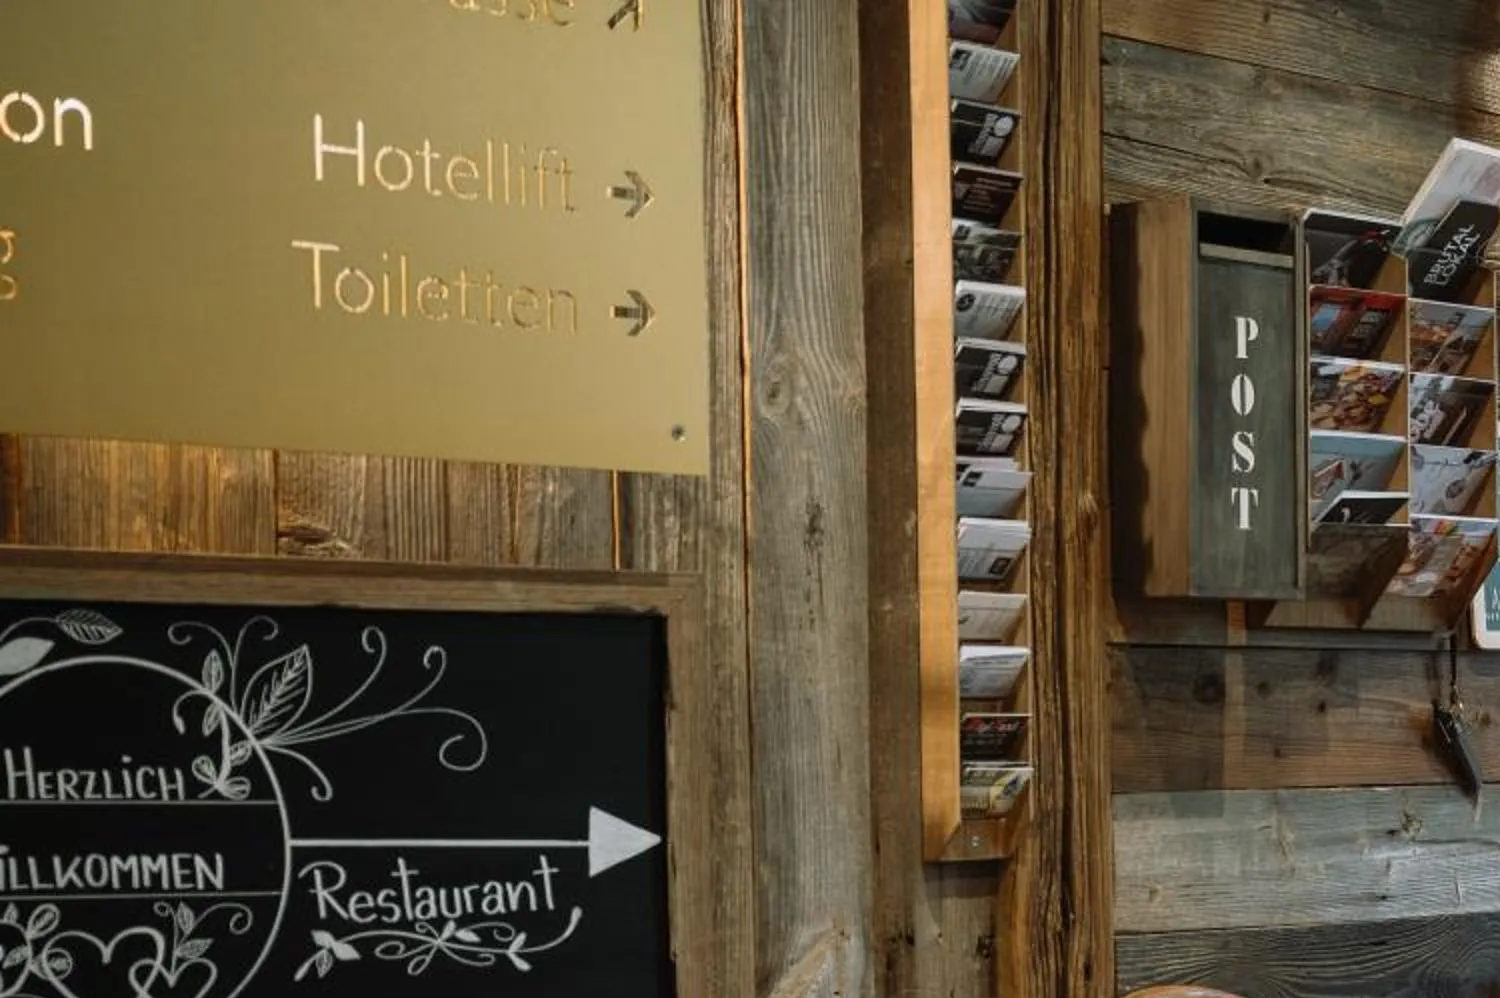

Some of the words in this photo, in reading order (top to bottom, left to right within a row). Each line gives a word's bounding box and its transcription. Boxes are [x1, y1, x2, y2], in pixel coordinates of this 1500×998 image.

[313, 113, 577, 212] Hotellift
[291, 240, 578, 335] Toiletten
[1231, 316, 1259, 530] POST
[297, 854, 560, 923] Restaurant
